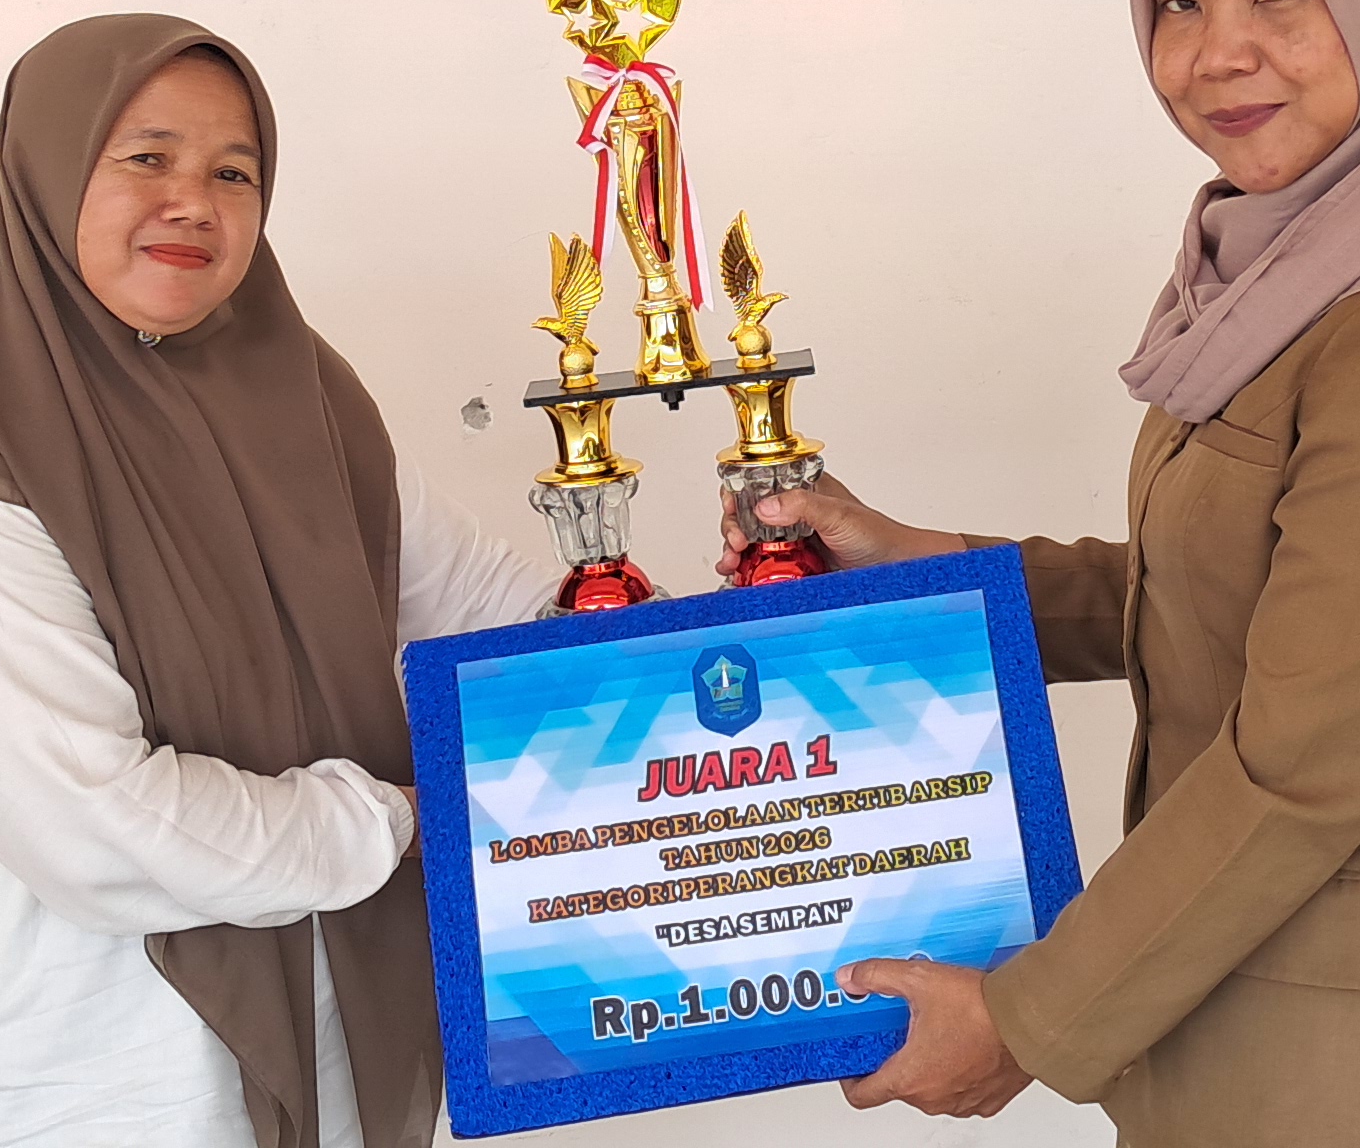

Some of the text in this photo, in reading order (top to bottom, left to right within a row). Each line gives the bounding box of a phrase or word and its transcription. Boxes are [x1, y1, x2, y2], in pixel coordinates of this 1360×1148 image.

[638, 734, 838, 802] JUARA 1
[490, 771, 993, 864] LOMBA PENGELOLAAN TERTIB ARSIP
[660, 826, 832, 871] TAHUN 2026
[527, 837, 971, 923] KATEGORI PERANGKAT DAERAH
[656, 915, 739, 948] "DESA
[592, 953, 936, 1042] Rp.1.000.
